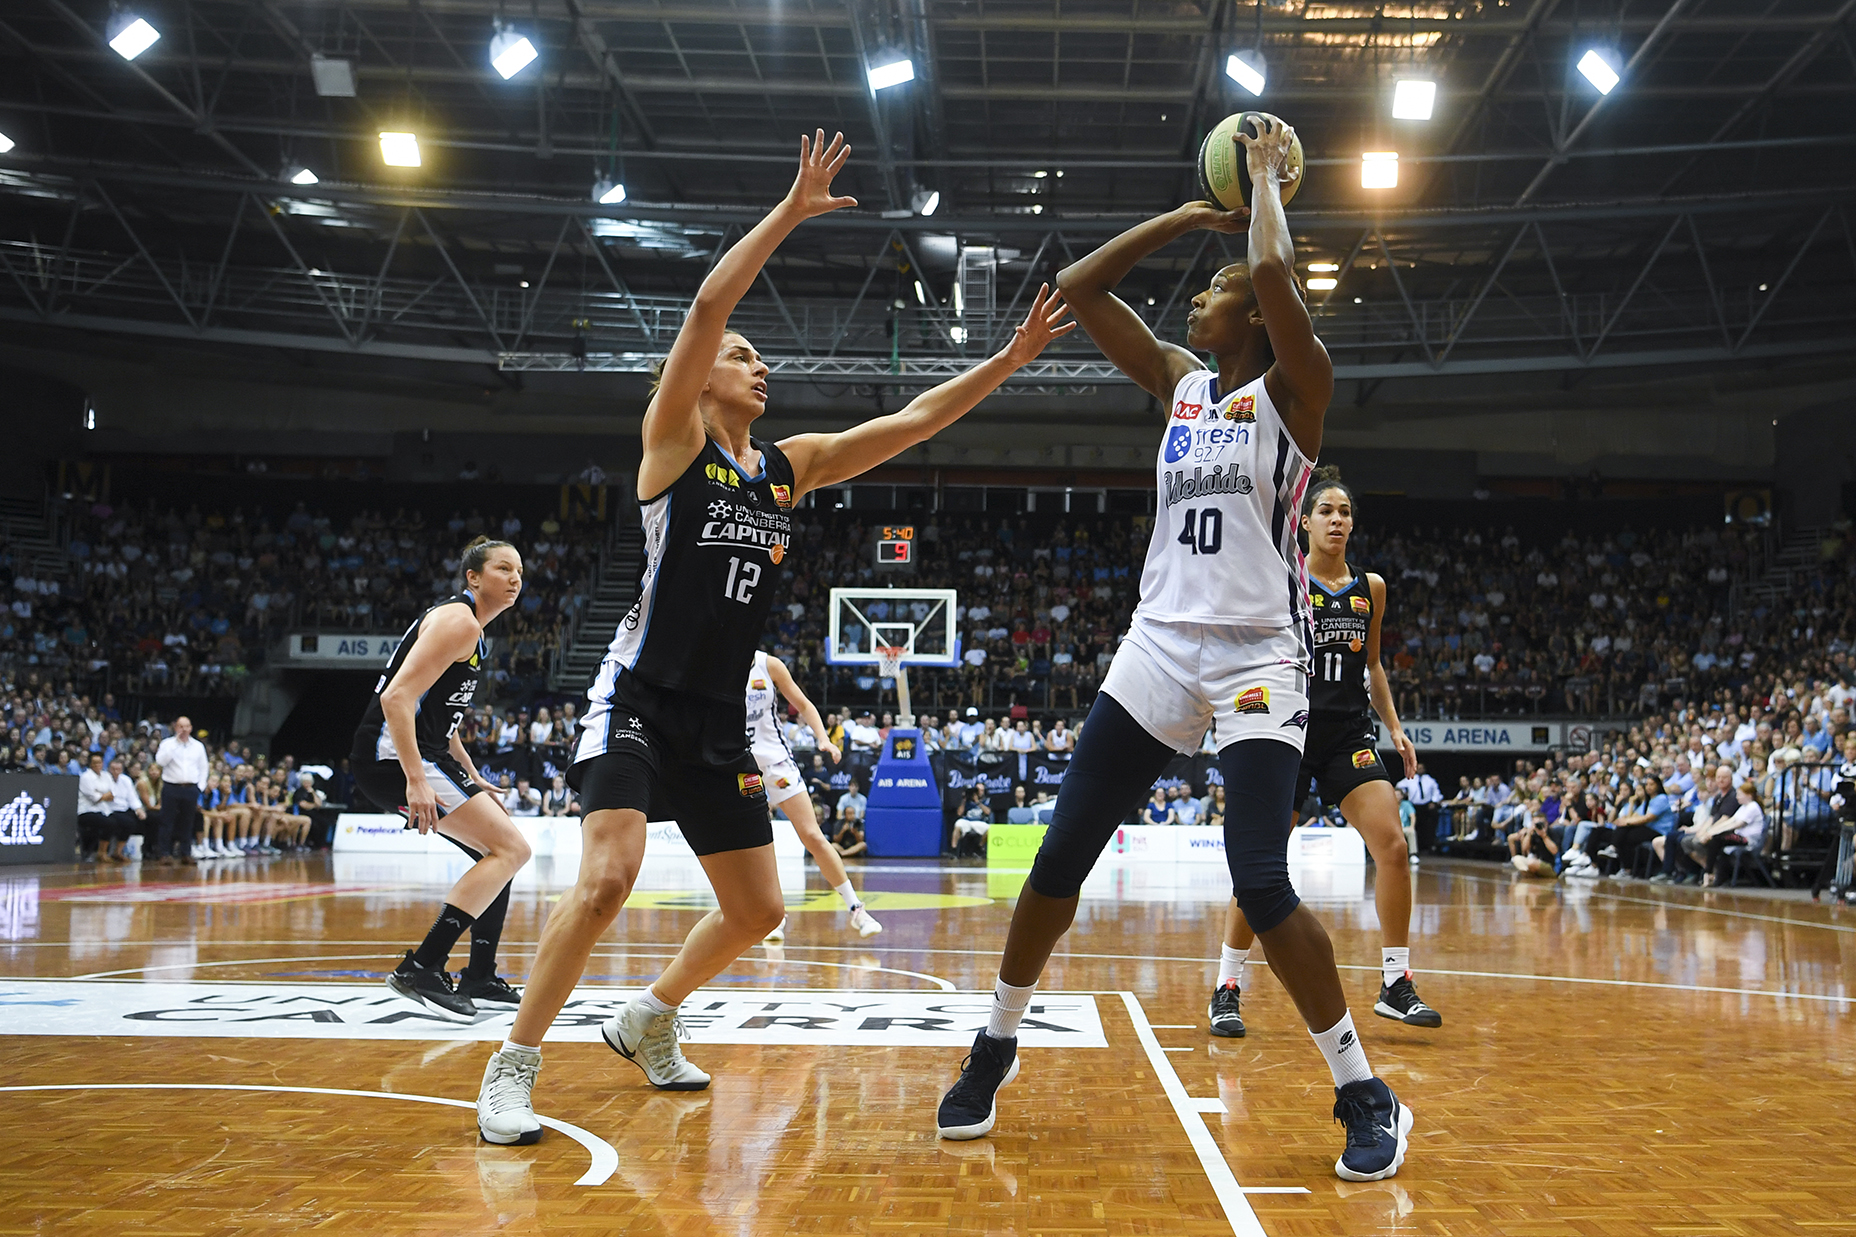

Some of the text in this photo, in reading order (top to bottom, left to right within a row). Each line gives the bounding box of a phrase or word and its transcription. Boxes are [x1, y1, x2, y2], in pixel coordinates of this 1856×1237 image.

[1196, 425, 1249, 445] fresh
[1194, 445, 1225, 463] 92.7
[735, 512, 792, 532] CANBERRA
[883, 526, 914, 540] 5:40
[1177, 508, 1223, 555] 40
[894, 542, 908, 561] 9
[724, 556, 762, 605] 12
[1321, 622, 1366, 630] CANBERRA
[1314, 630, 1366, 643] APITALS
[338, 640, 368, 655] AIS
[1323, 652, 1342, 682] 11
[1443, 729, 1511, 744] ARENA
[896, 750, 911, 759] AIS
[878, 778, 928, 788] AIS ARENA
